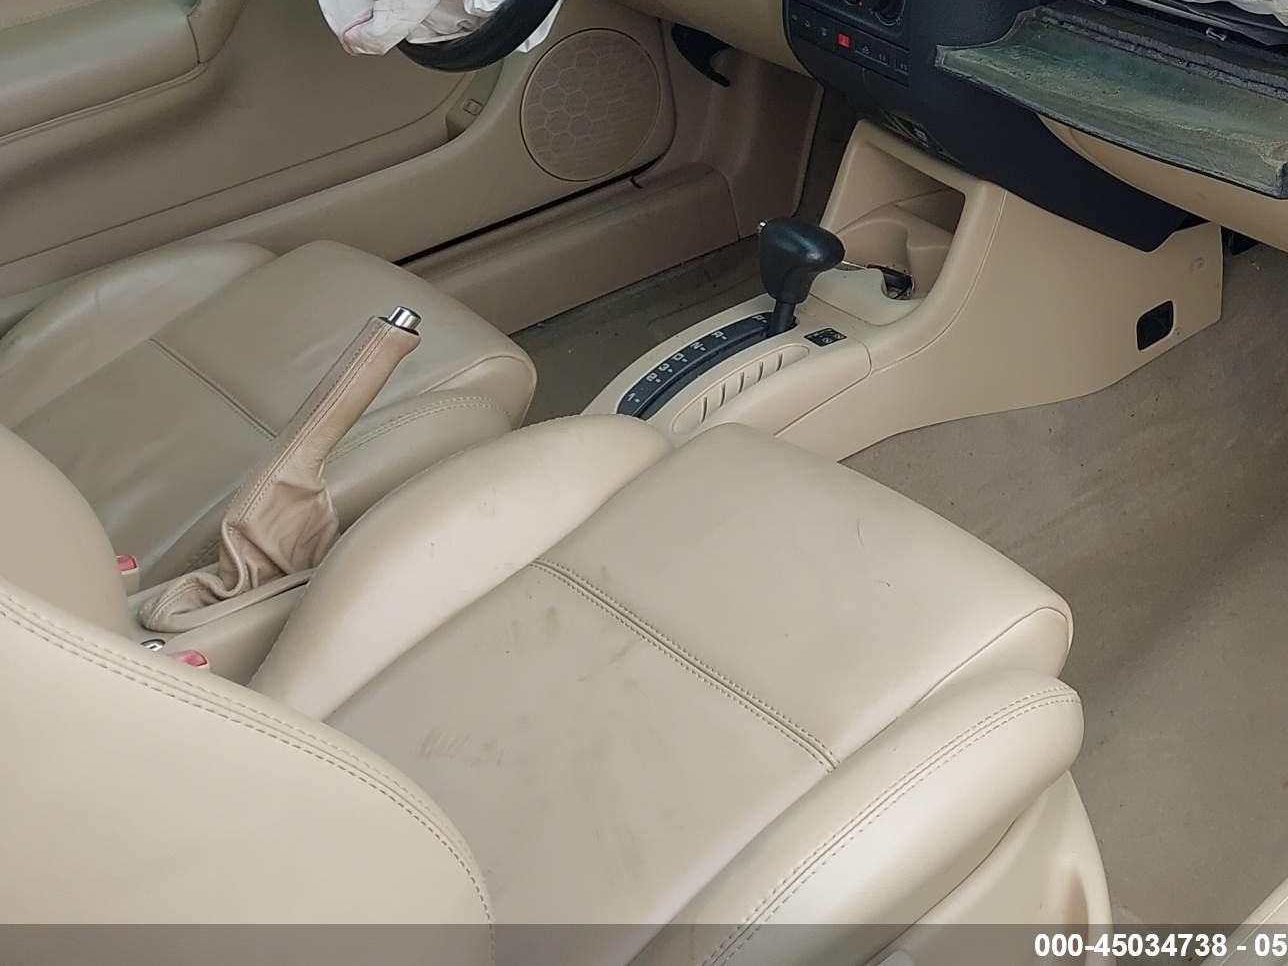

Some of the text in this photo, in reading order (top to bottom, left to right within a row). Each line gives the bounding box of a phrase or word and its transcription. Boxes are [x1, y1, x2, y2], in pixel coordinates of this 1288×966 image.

[690, 341, 702, 350] N
[672, 352, 684, 361] D
[658, 362, 669, 372] 3
[627, 393, 636, 403] 1
